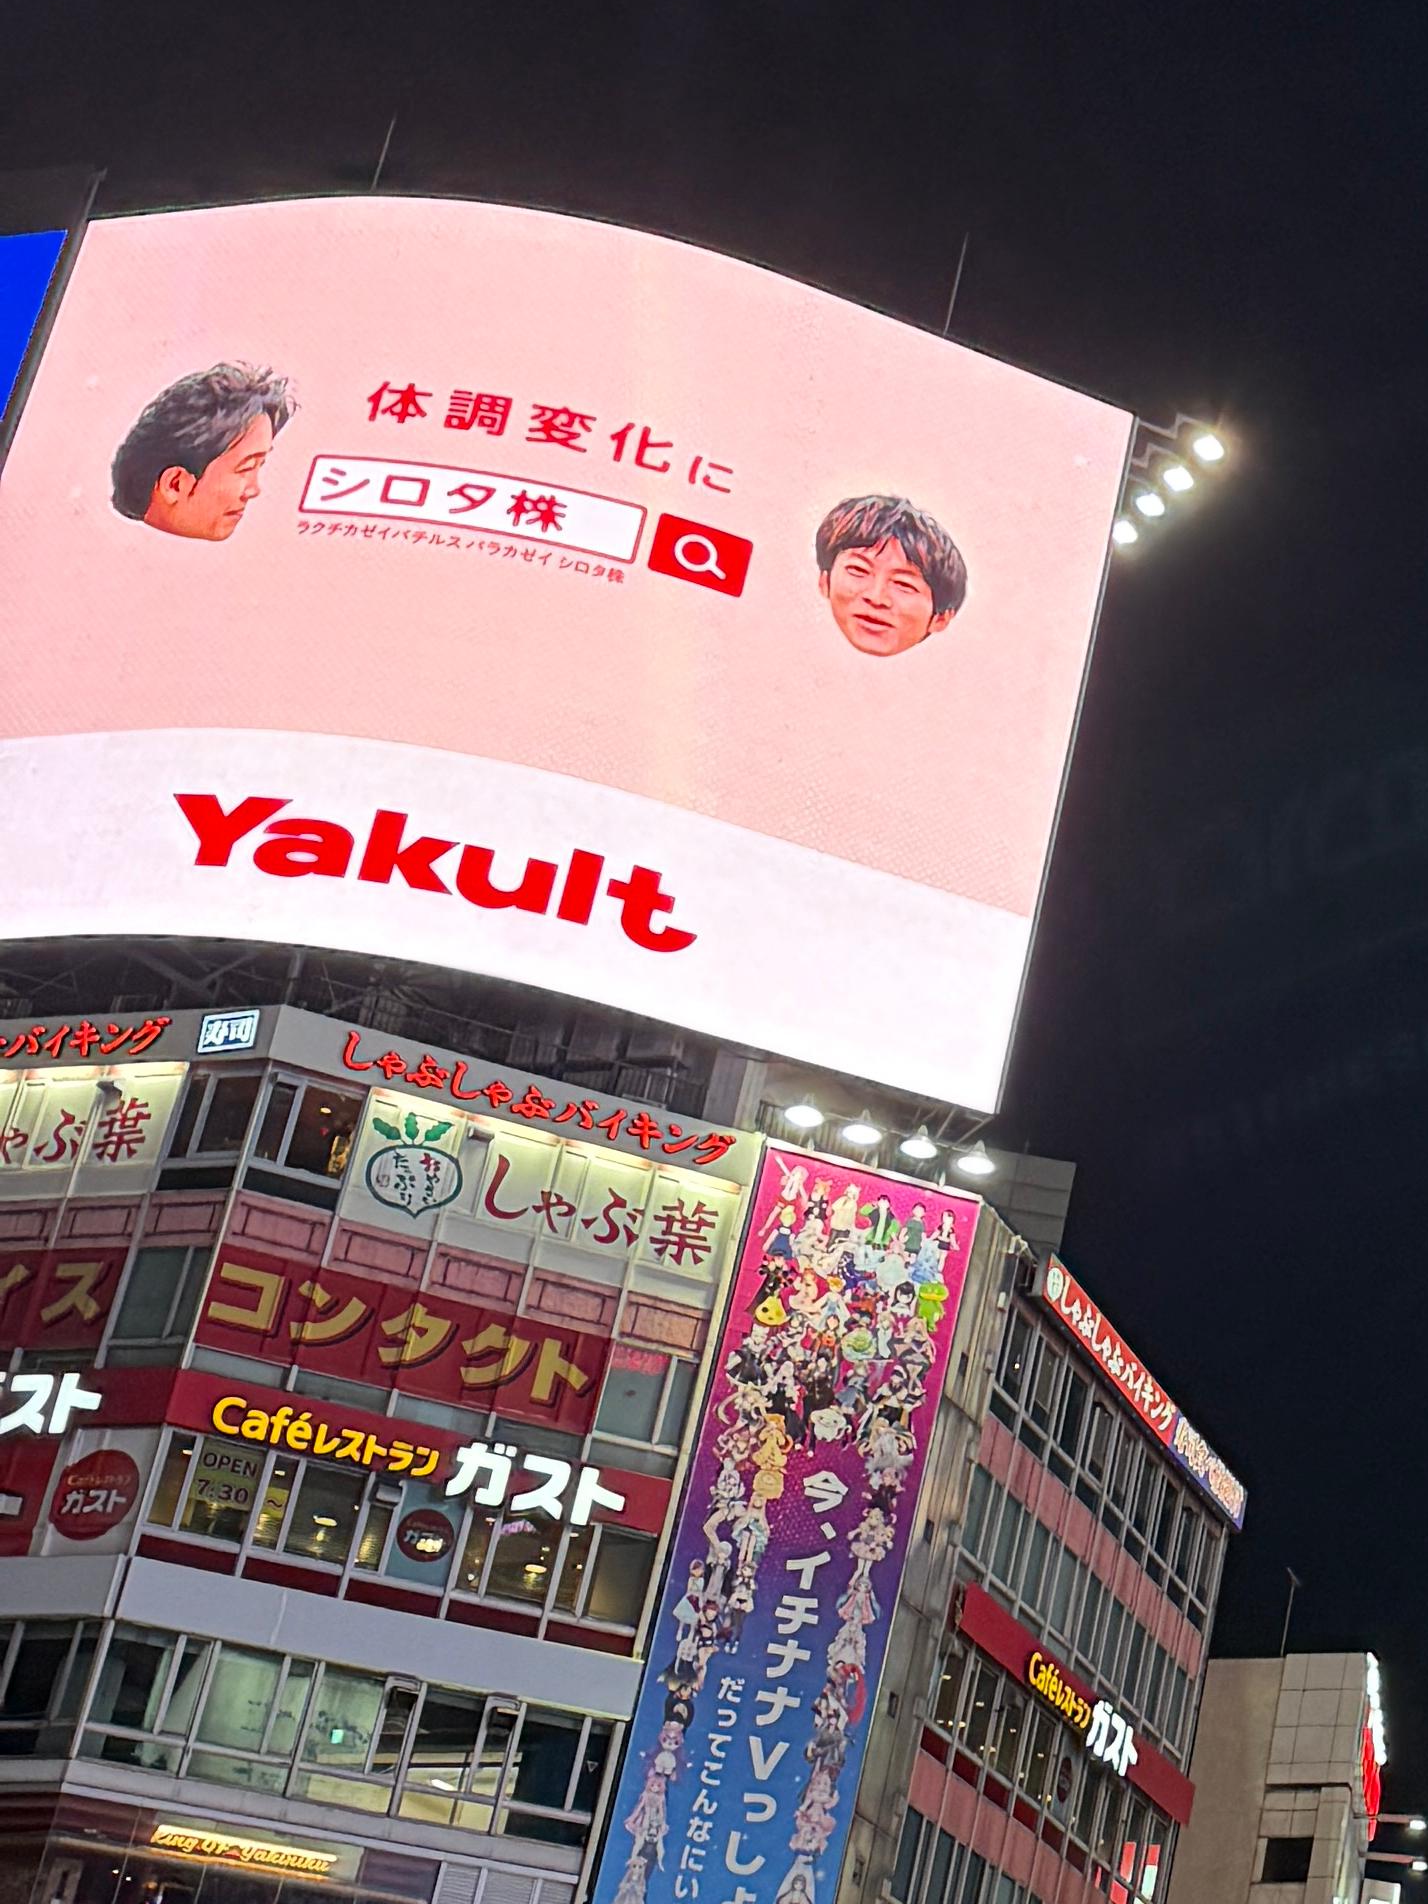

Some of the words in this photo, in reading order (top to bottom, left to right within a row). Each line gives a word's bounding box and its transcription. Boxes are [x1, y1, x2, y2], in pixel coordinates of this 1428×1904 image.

[366, 380, 734, 494] 体調変化に
[320, 467, 568, 533] シロタ株
[172, 792, 698, 954] Yakult
[0, 1016, 173, 1059] バイキング
[341, 1030, 739, 1166] しゃぶしゃぶバイキング
[481, 1153, 720, 1268] しゃぶ葉
[203, 1259, 592, 1405] コンタクト
[0, 1371, 102, 1435] スト
[61, 1490, 128, 1516] ガスト
[196, 1479, 250, 1506] 7:30
[201, 1452, 259, 1479] OPEN
[212, 1396, 440, 1478] Caféレストラン
[445, 1441, 626, 1527] ガスト
